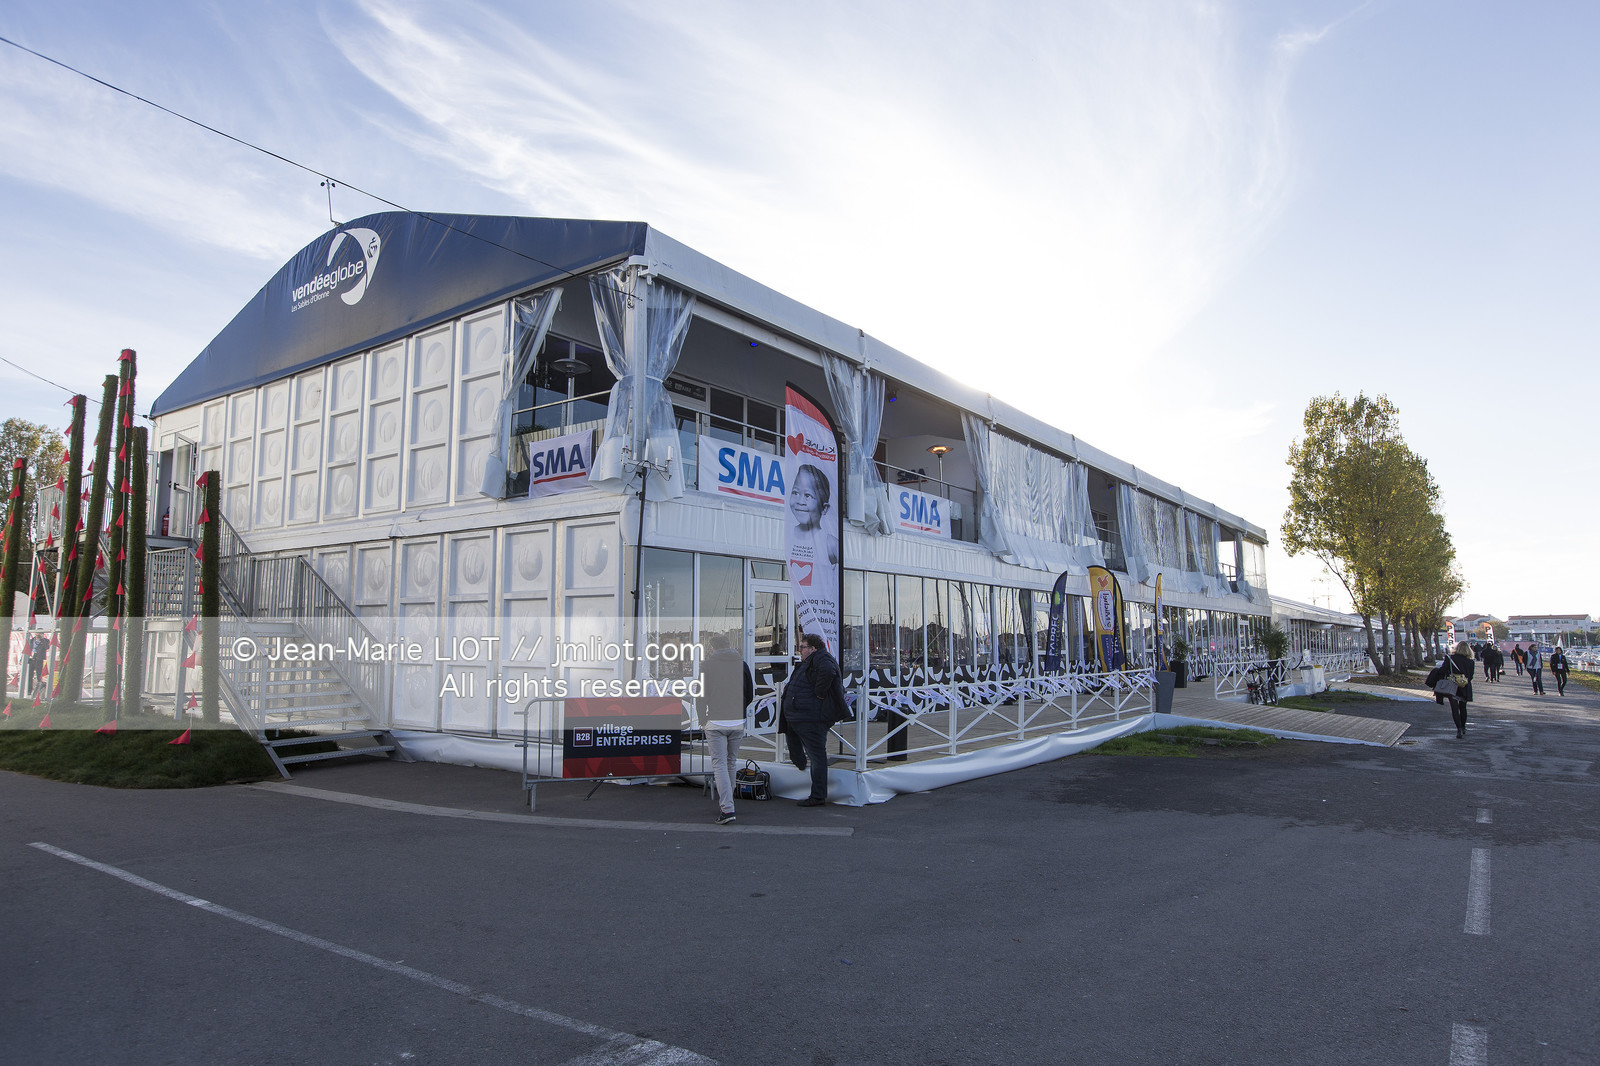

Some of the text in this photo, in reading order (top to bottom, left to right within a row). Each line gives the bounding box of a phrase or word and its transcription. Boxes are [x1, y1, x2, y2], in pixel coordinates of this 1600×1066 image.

[532, 444, 585, 478] SMA
[718, 447, 785, 496] SMA
[900, 491, 941, 527] SMA
[575, 733, 591, 741] B2B
[596, 723, 634, 736] village
[596, 735, 673, 747] ENTREPRISES
